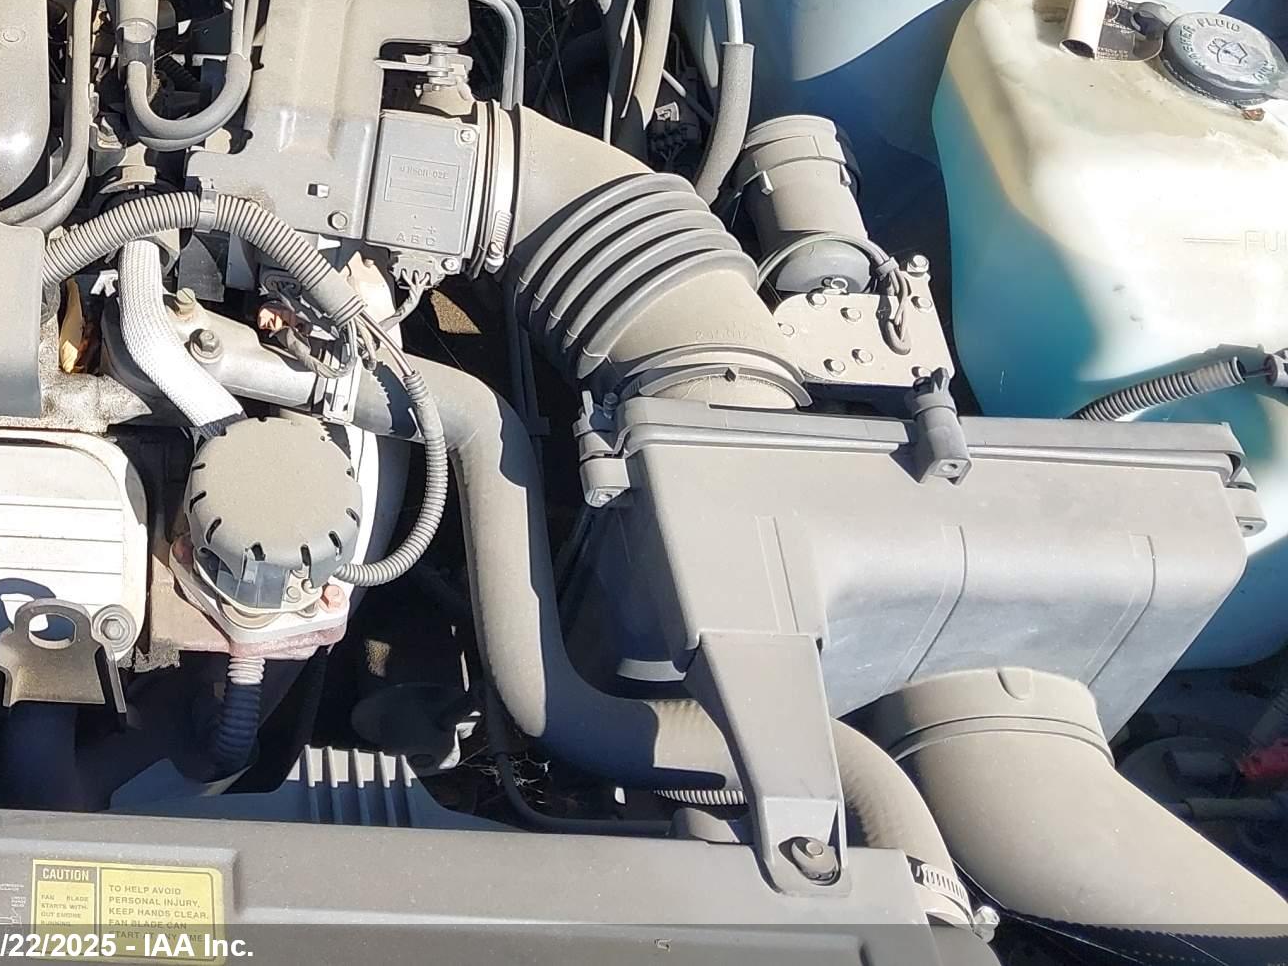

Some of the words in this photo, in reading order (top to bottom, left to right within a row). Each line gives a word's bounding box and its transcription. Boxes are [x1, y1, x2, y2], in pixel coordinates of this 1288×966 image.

[1196, 17, 1241, 33] FLUID
[42, 867, 89, 881] CAUTION
[124, 886, 150, 894] HELP
[152, 887, 182, 895] AVOID
[109, 897, 161, 906] PERSONAL
[164, 898, 201, 908] INJURY,
[109, 907, 135, 915] KEEP
[137, 909, 172, 917] HANDS
[174, 911, 209, 919] CLEAR.
[109, 919, 128, 927] FAN
[132, 920, 163, 928] BLADE
[166, 922, 187, 930] CAN
